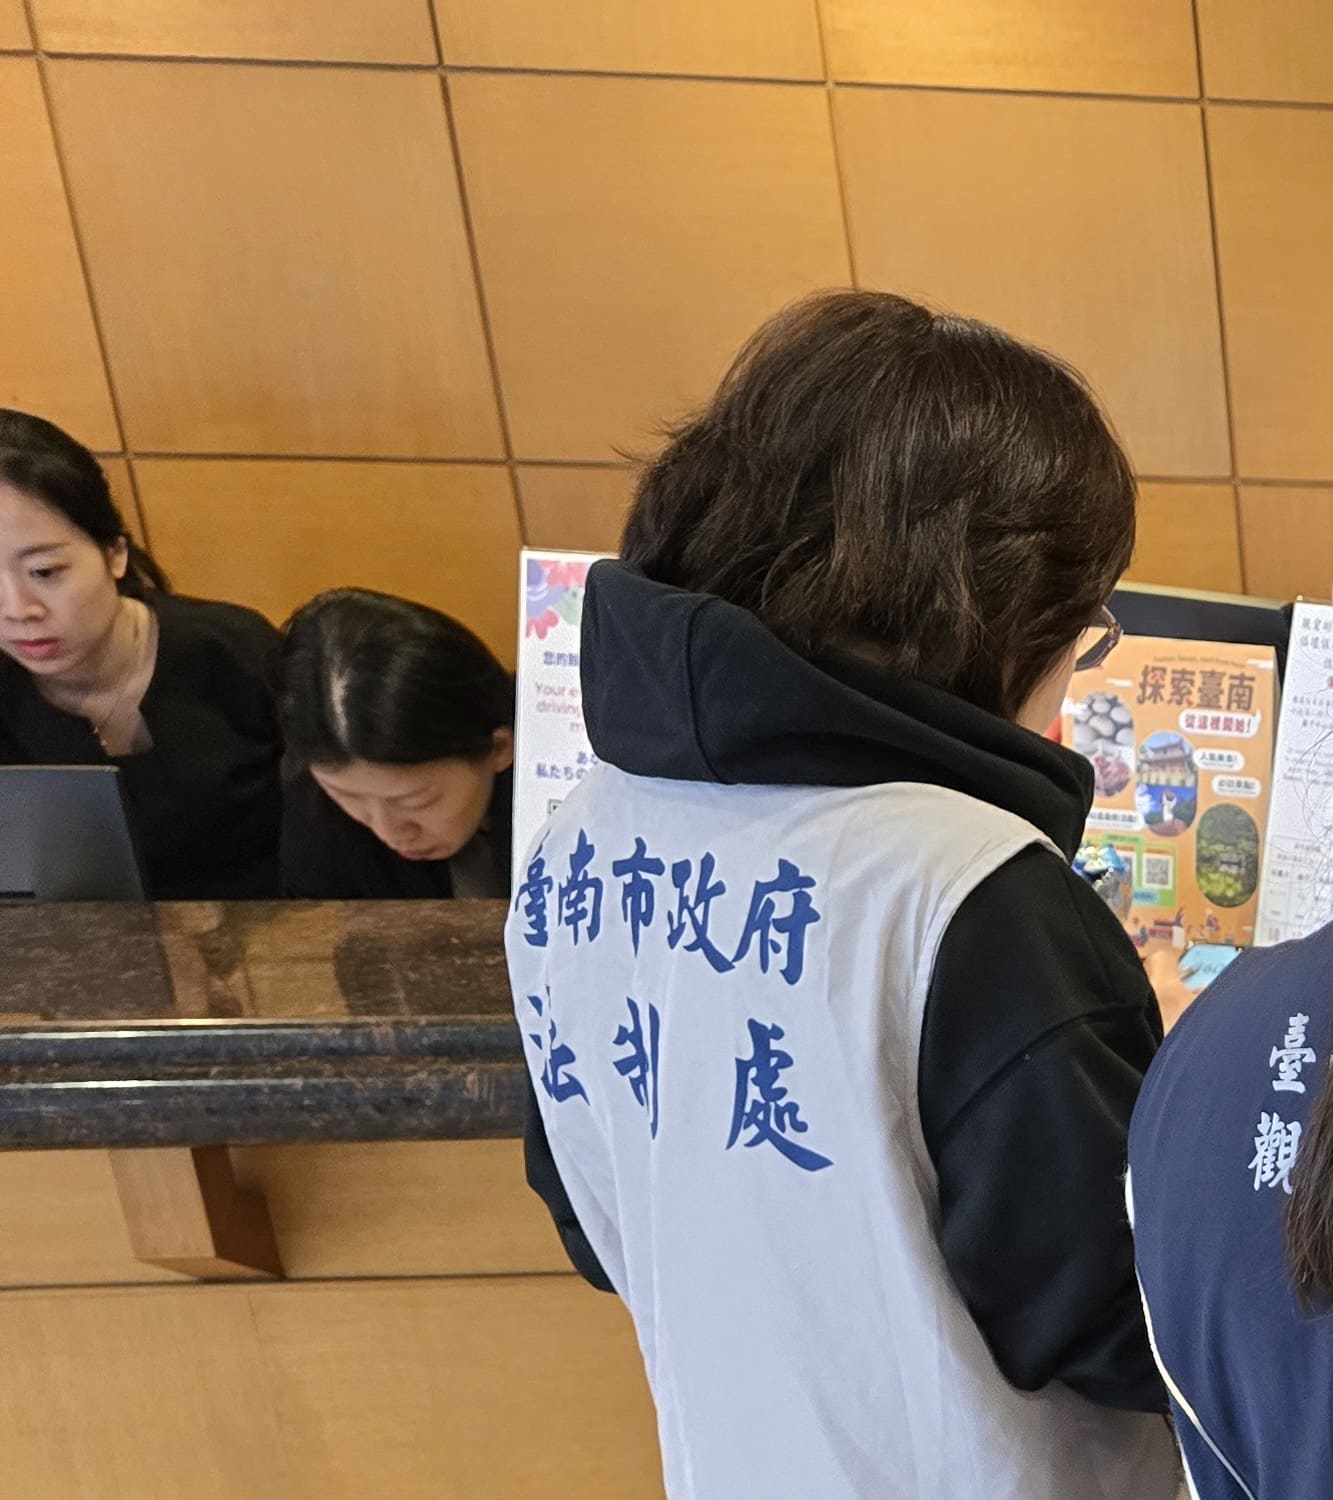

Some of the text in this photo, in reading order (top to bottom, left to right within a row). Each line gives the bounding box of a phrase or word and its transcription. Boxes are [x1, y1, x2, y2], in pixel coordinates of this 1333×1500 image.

[1137, 664, 1256, 712] 探索臺南
[514, 828, 822, 986] 臺南市政府
[526, 985, 834, 1173] 法制處
